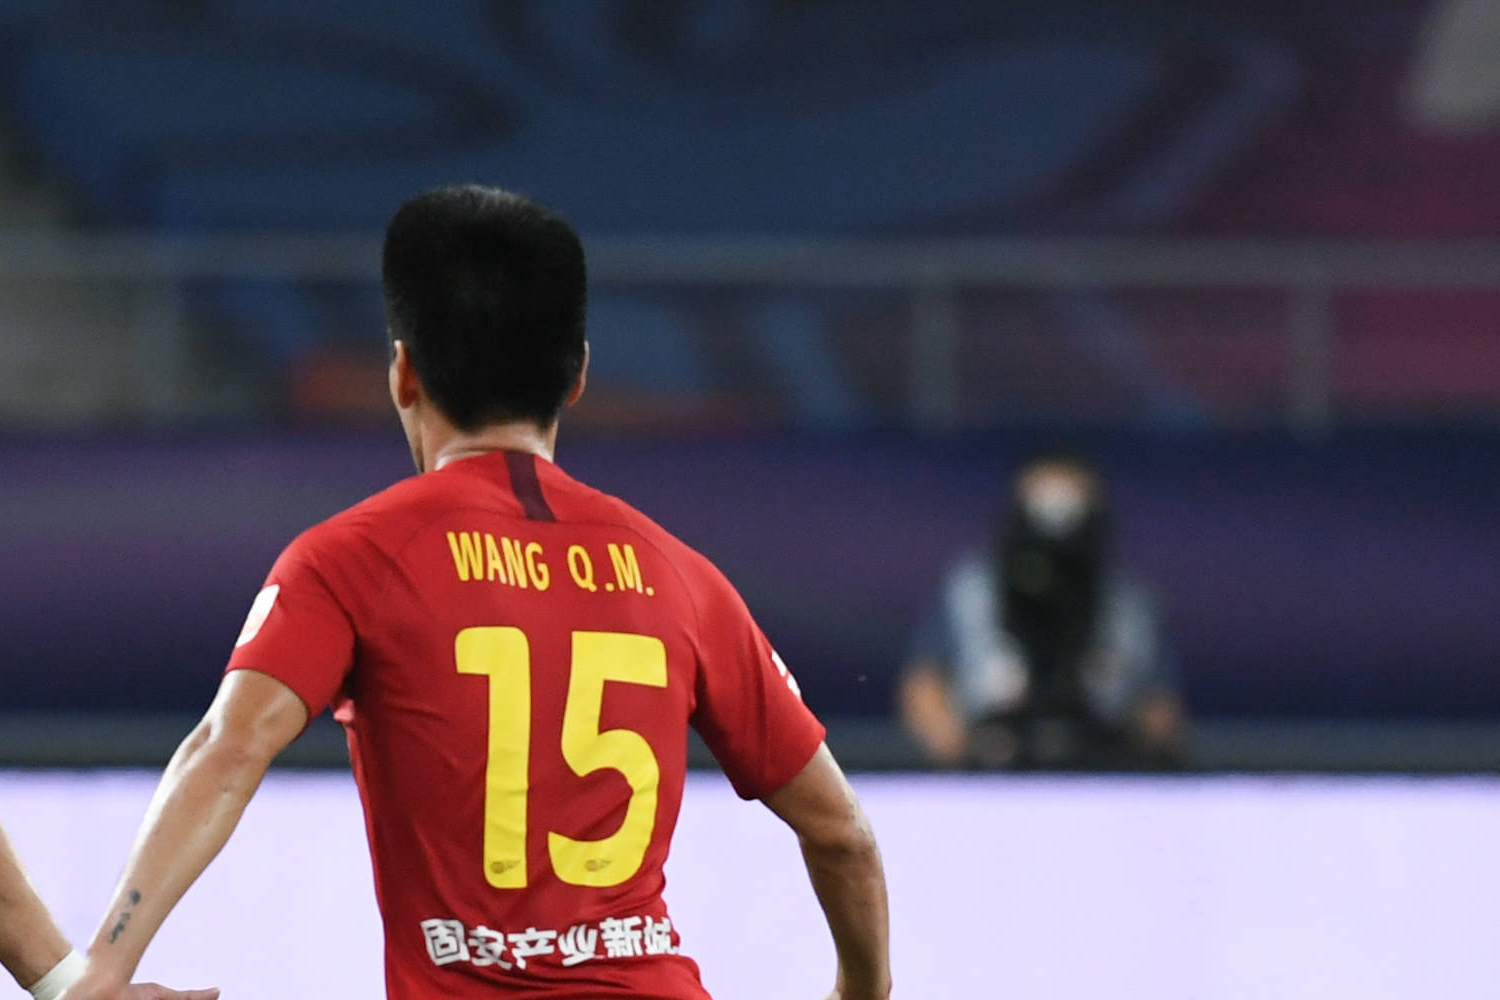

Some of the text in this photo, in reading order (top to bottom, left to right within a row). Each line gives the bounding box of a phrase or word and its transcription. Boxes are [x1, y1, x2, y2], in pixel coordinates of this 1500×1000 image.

[446, 531, 654, 596] WANG Q.M.
[454, 626, 668, 889] 15
[420, 916, 680, 970] 固安产业新城
